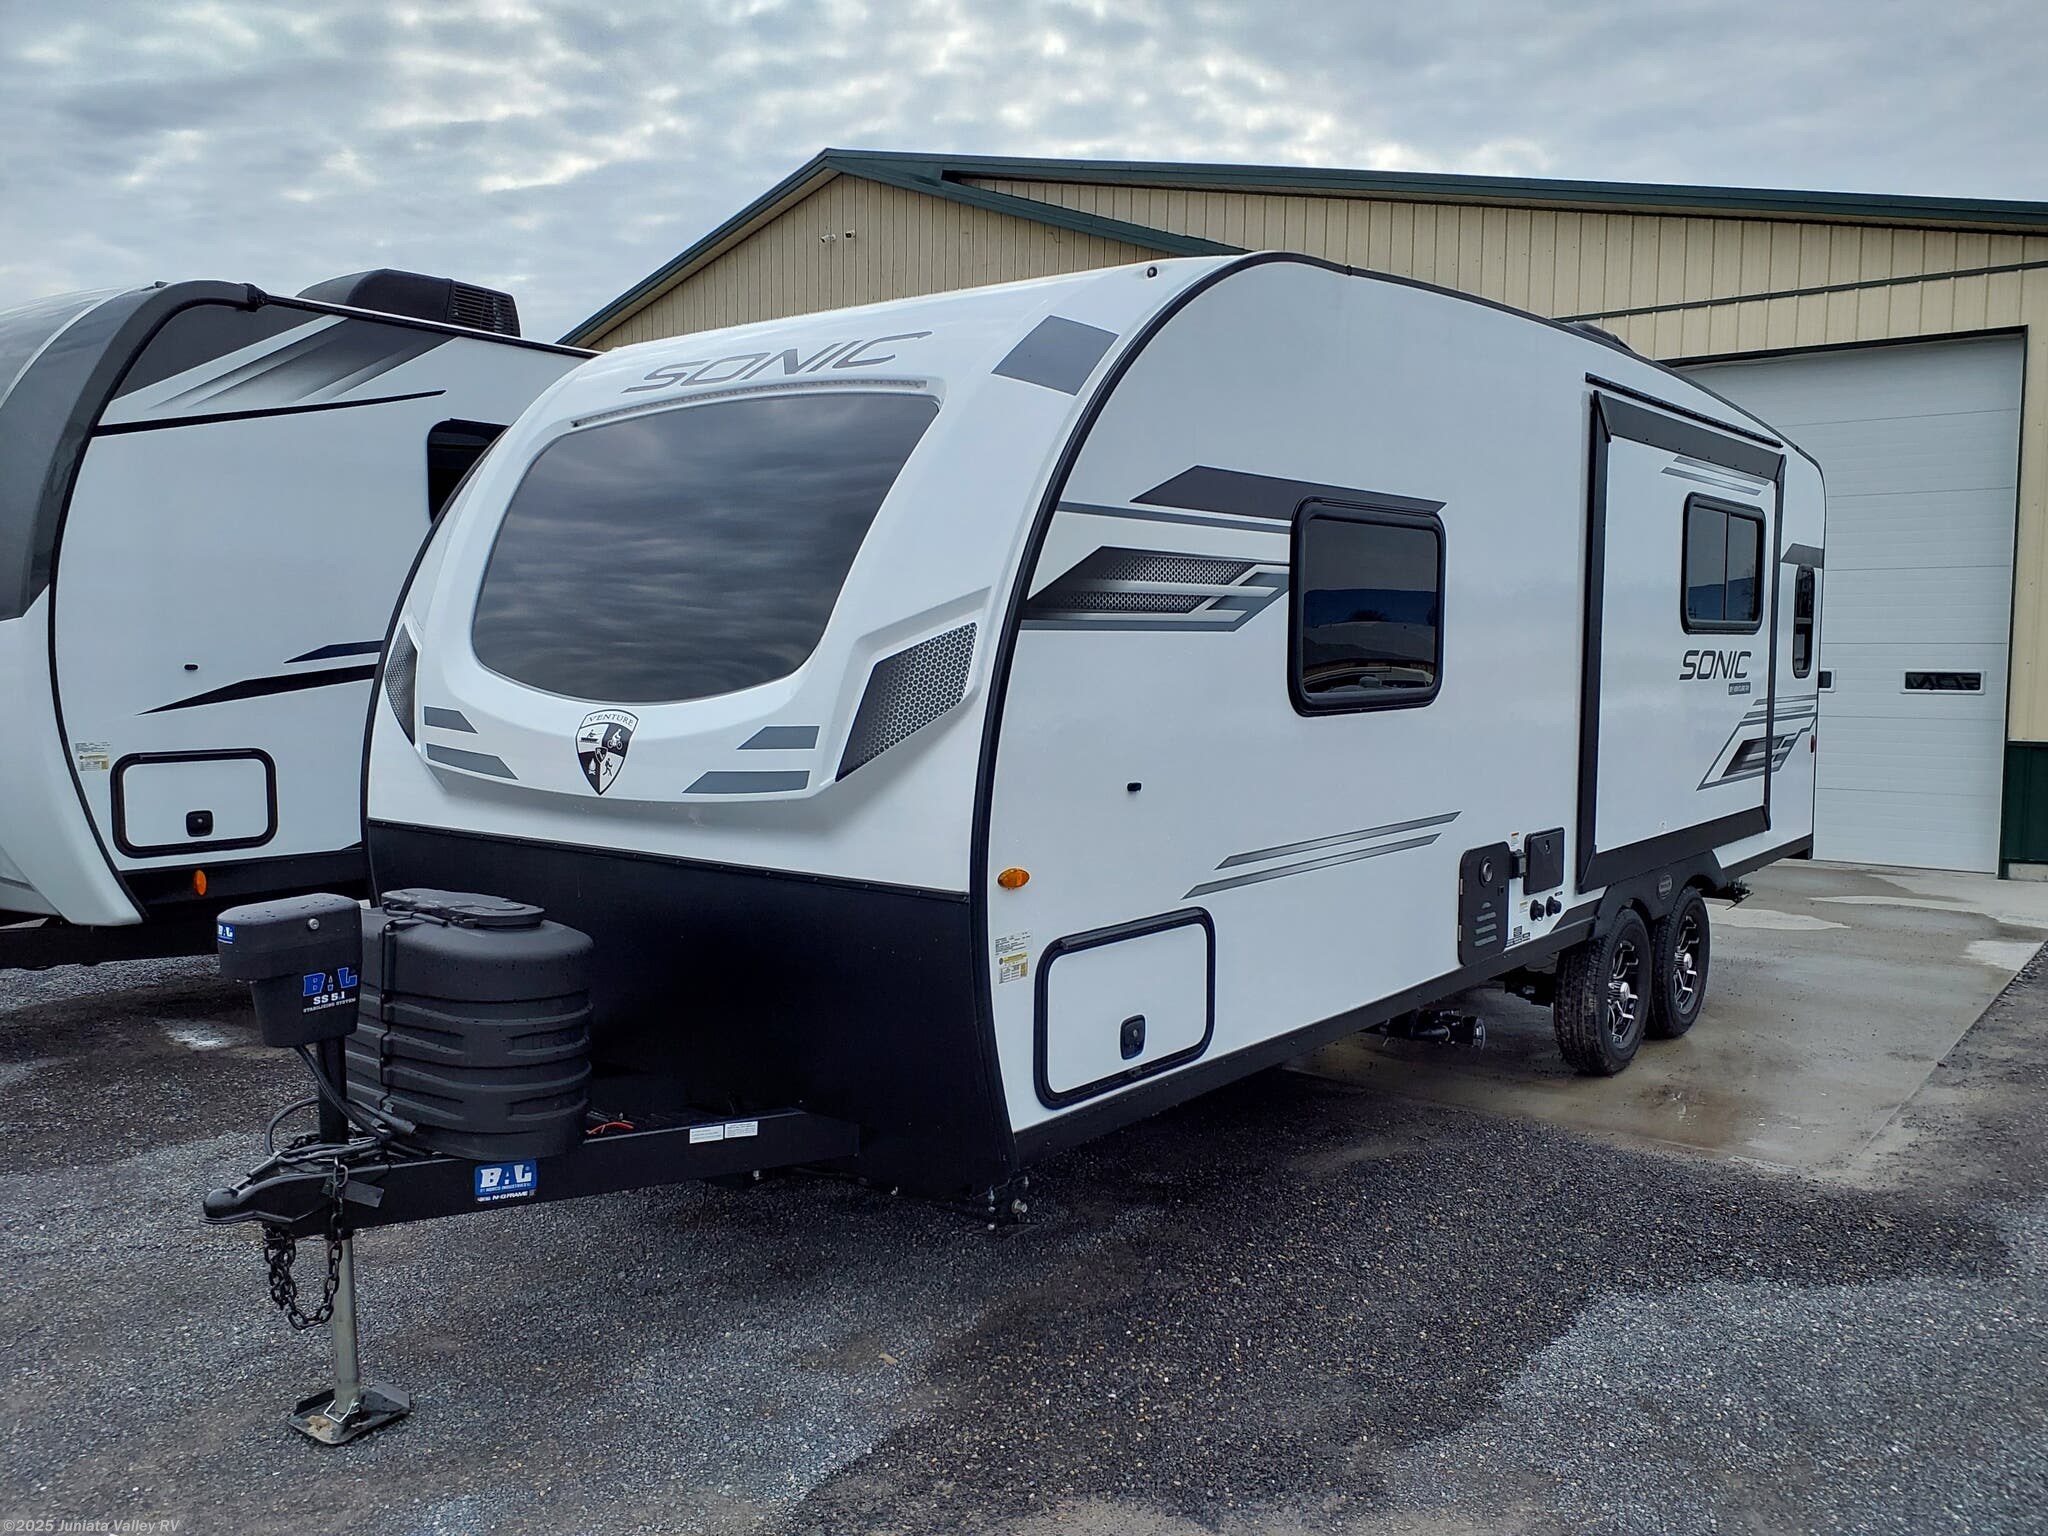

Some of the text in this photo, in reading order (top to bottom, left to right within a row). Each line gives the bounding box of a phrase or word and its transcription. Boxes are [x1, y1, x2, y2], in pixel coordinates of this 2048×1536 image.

[621, 331, 933, 393] SONIC
[1679, 650, 1752, 680] SONIC
[587, 714, 635, 727] VENTURE
[313, 995, 329, 1005] SS
